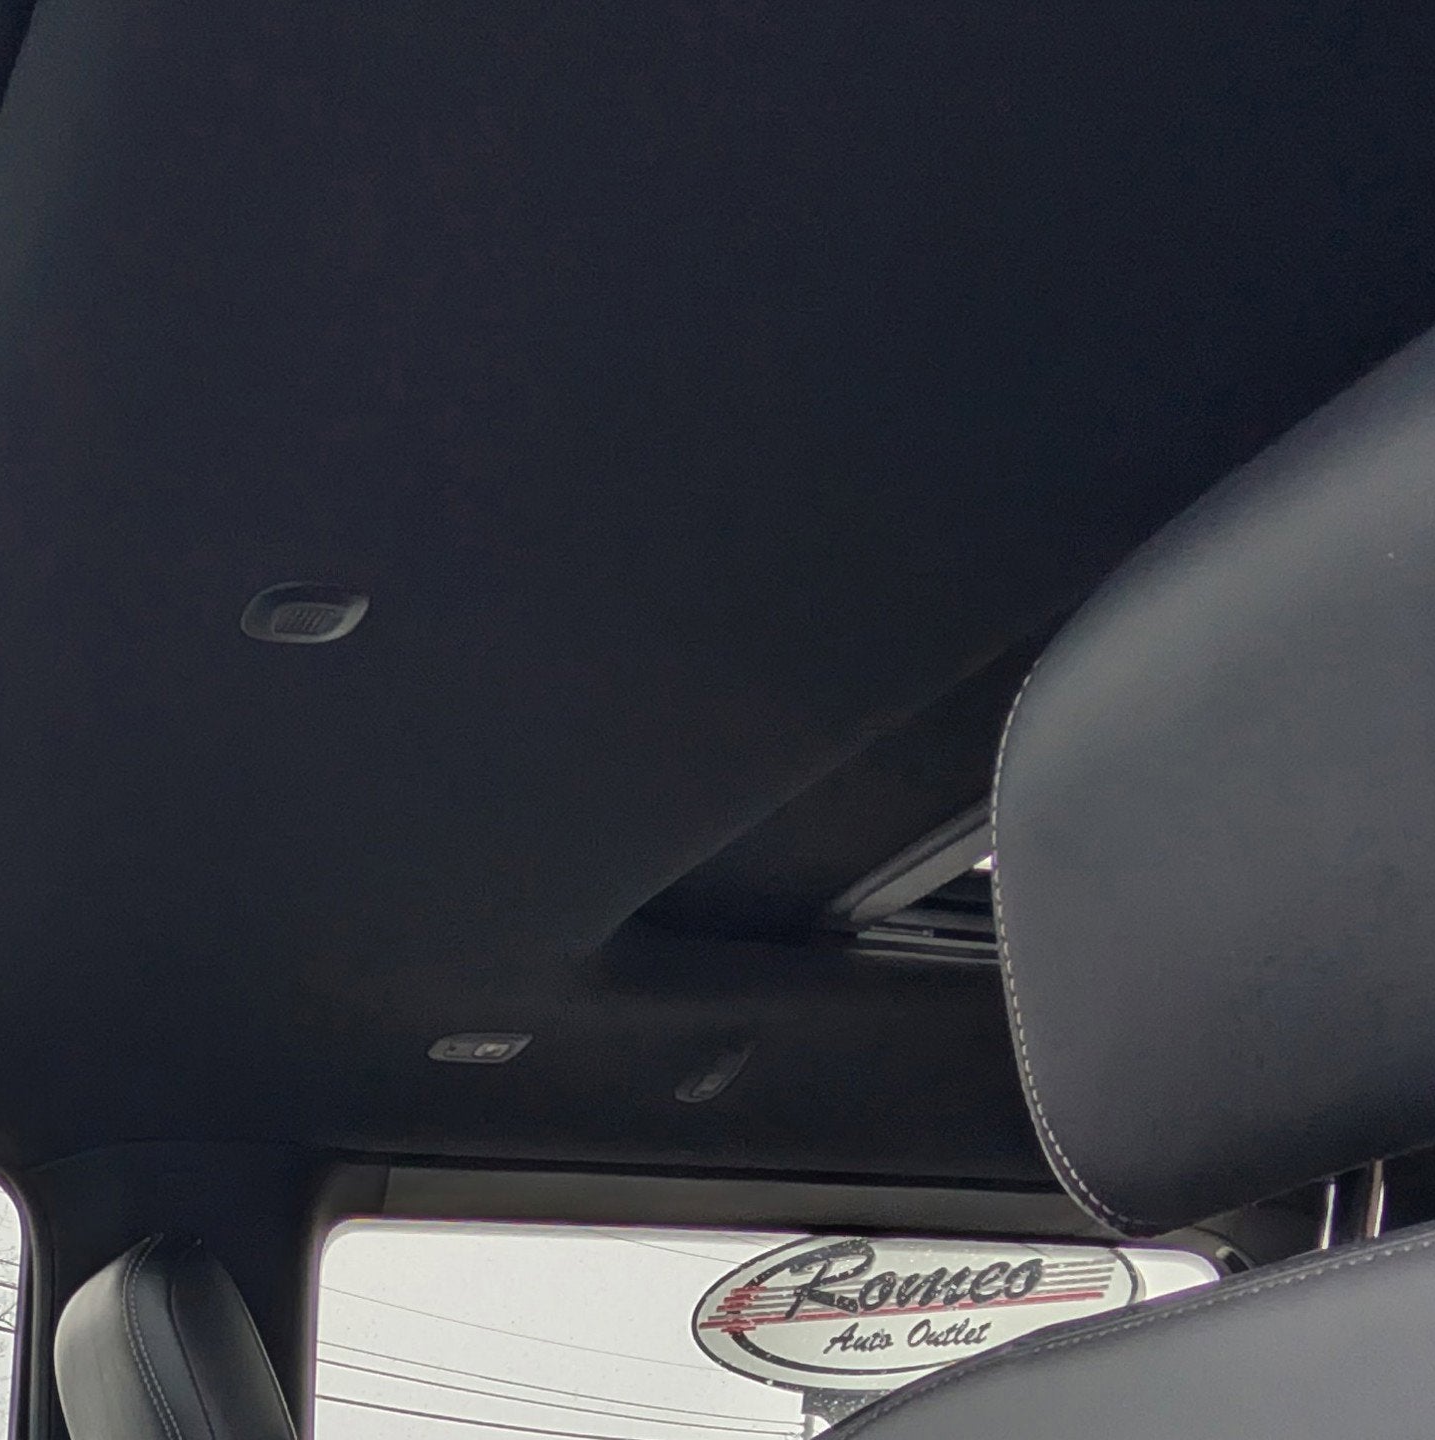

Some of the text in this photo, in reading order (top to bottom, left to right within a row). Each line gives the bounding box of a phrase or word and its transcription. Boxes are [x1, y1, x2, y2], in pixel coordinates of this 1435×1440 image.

[738, 1236, 1044, 1320] Romeo
[823, 1318, 992, 1355] Auto Outlet
